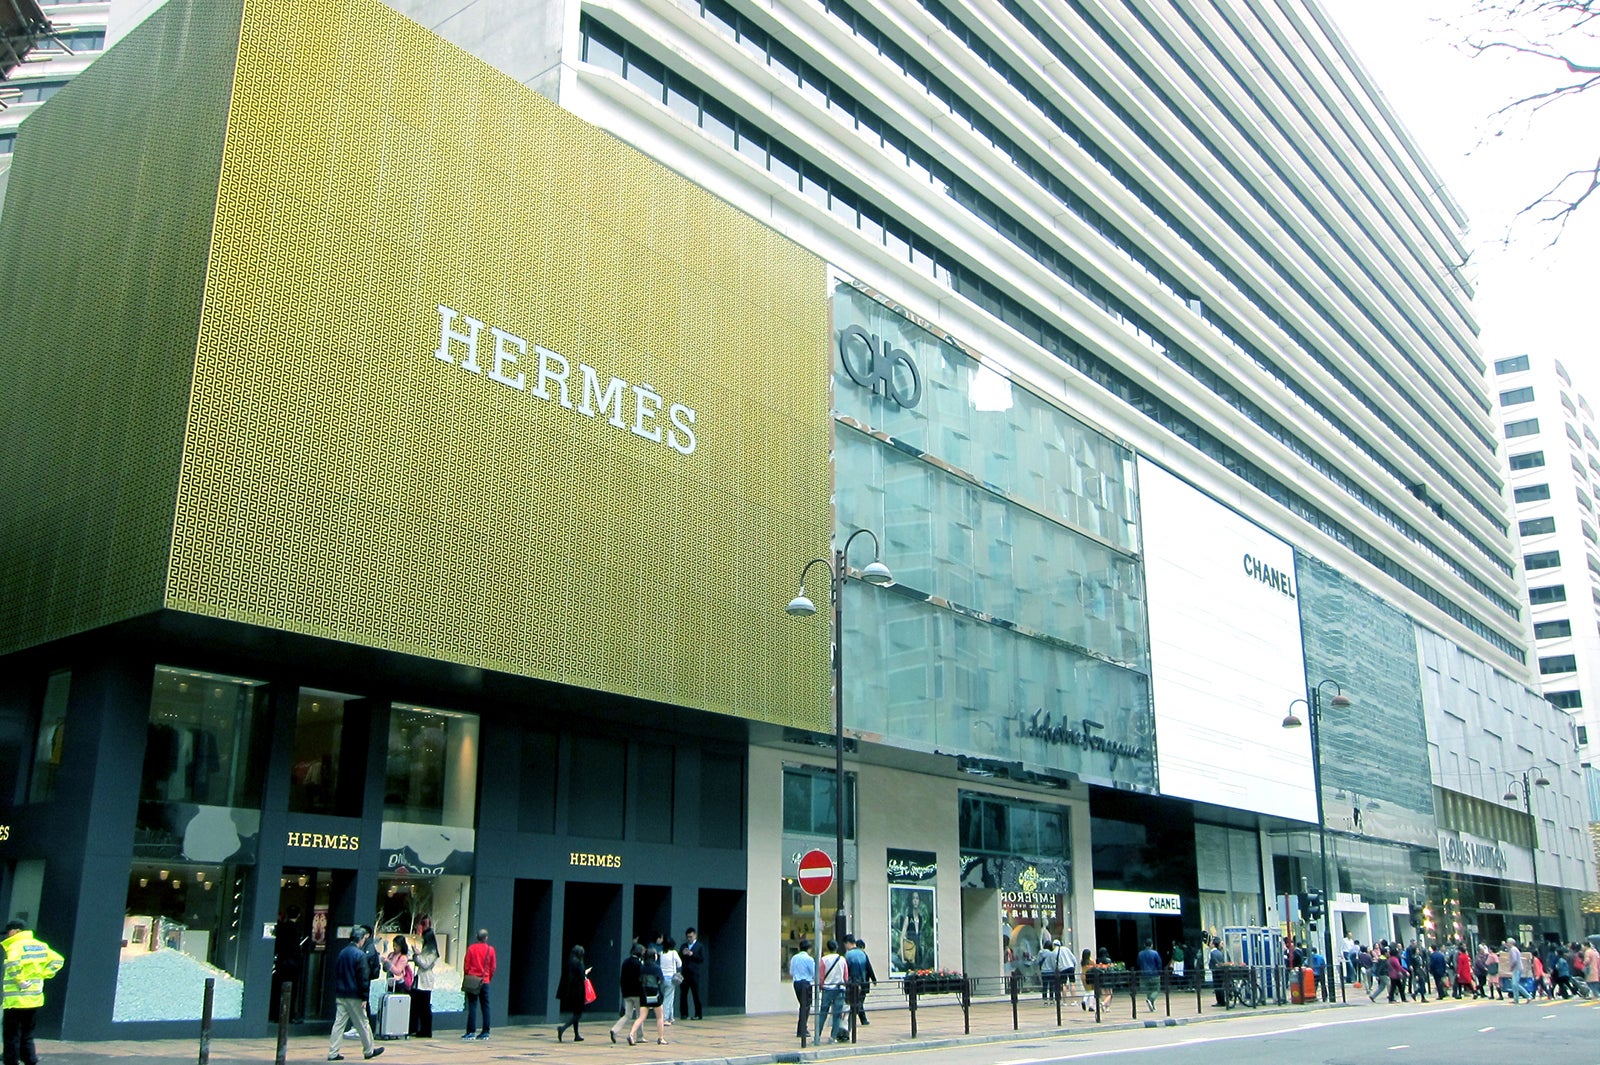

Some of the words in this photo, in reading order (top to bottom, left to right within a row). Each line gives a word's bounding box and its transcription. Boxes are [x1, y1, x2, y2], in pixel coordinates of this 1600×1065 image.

[434, 304, 697, 455] HERMÈS
[1243, 553, 1296, 599] CHANEL
[287, 832, 360, 851] HERMÈS
[1149, 896, 1181, 910] CHANEL
